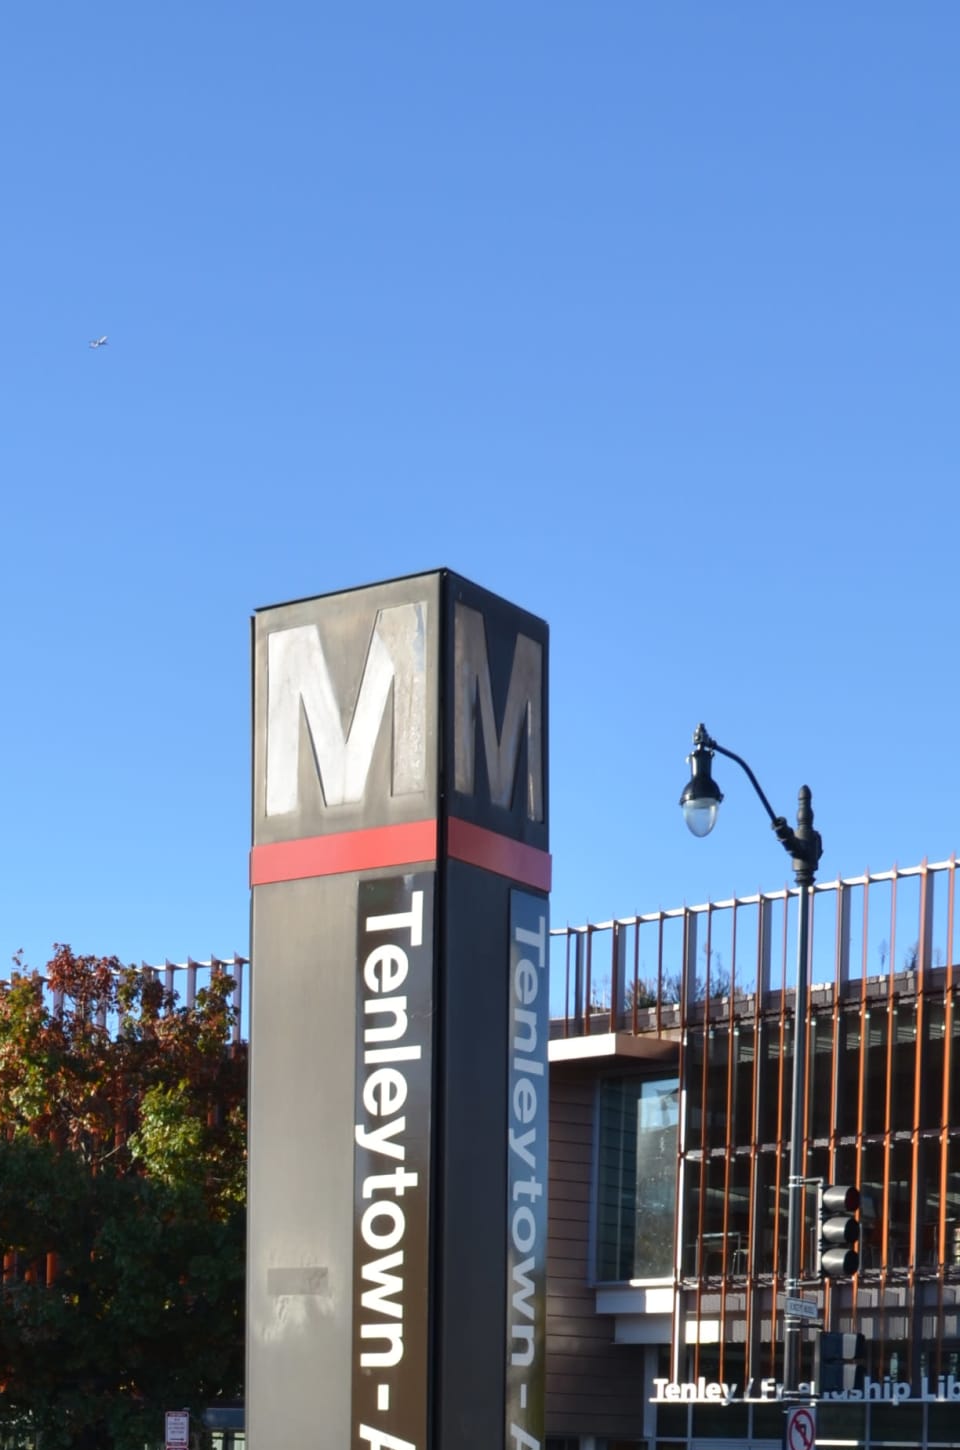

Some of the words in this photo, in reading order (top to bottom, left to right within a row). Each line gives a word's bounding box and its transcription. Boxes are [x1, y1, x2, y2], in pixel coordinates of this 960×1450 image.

[265, 601, 427, 817] M
[453, 601, 545, 824] M
[355, 890, 424, 1368] Tenleytown
[508, 915, 546, 1367] Tenleytown
[653, 1376, 738, 1406] Tenley
